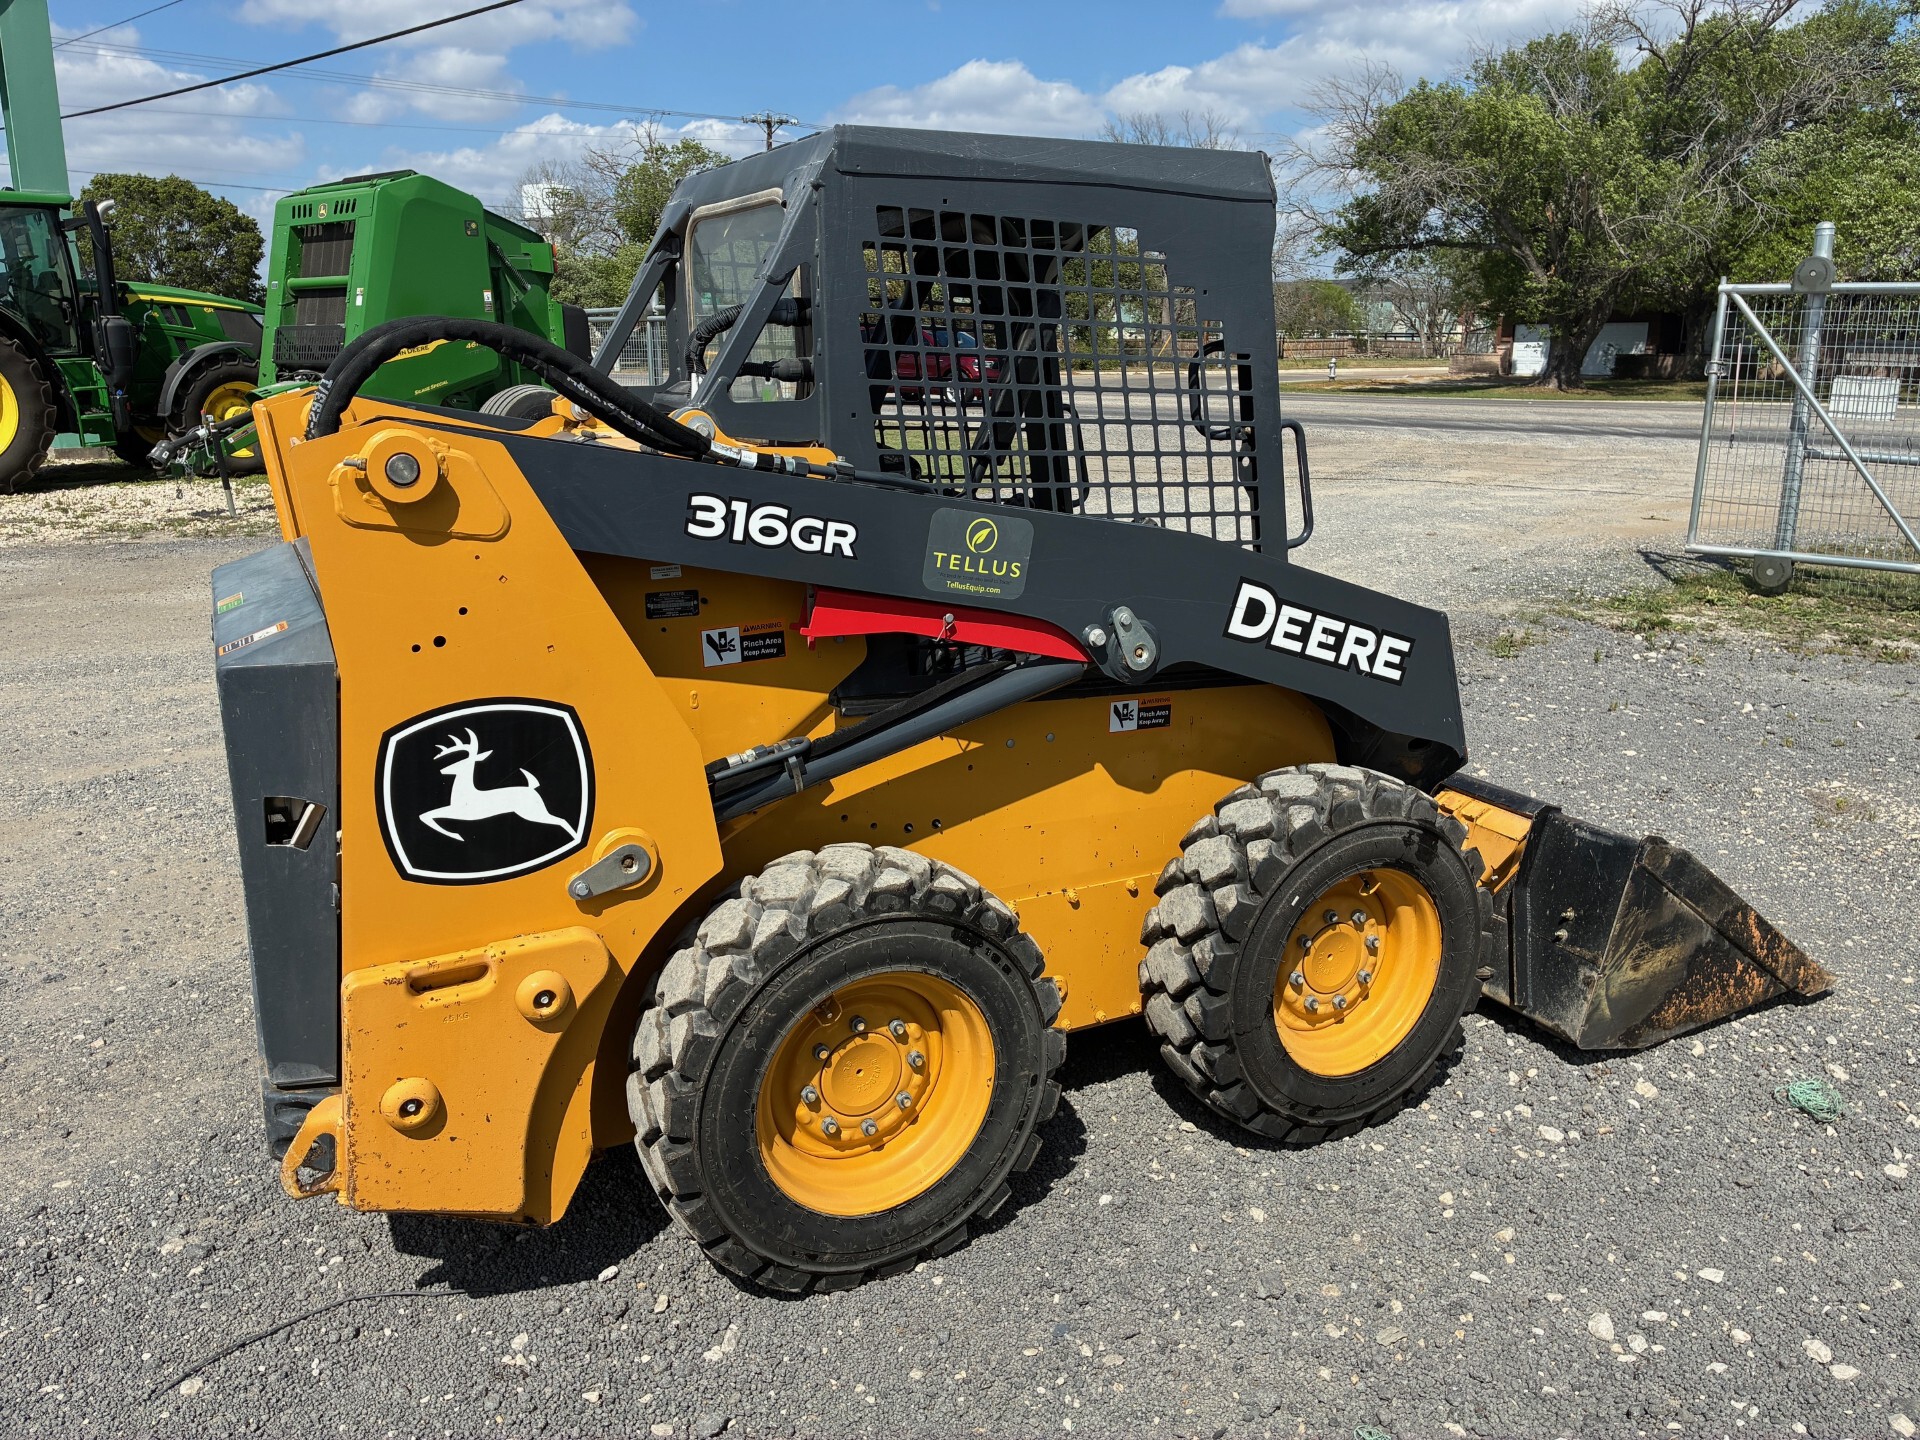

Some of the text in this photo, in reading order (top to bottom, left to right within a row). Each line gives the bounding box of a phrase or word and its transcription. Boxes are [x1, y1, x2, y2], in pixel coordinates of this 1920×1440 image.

[407, 345, 430, 354] DEERE
[686, 494, 857, 558] 316GR
[933, 551, 1022, 578] TELLUS
[946, 580, 1001, 594] TellusEquip.com
[748, 621, 782, 632] WARNING
[1227, 582, 1412, 681] DEERE
[743, 637, 782, 648] Pinch Area
[743, 647, 778, 657] Keep Away
[1147, 696, 1171, 704] WARNING
